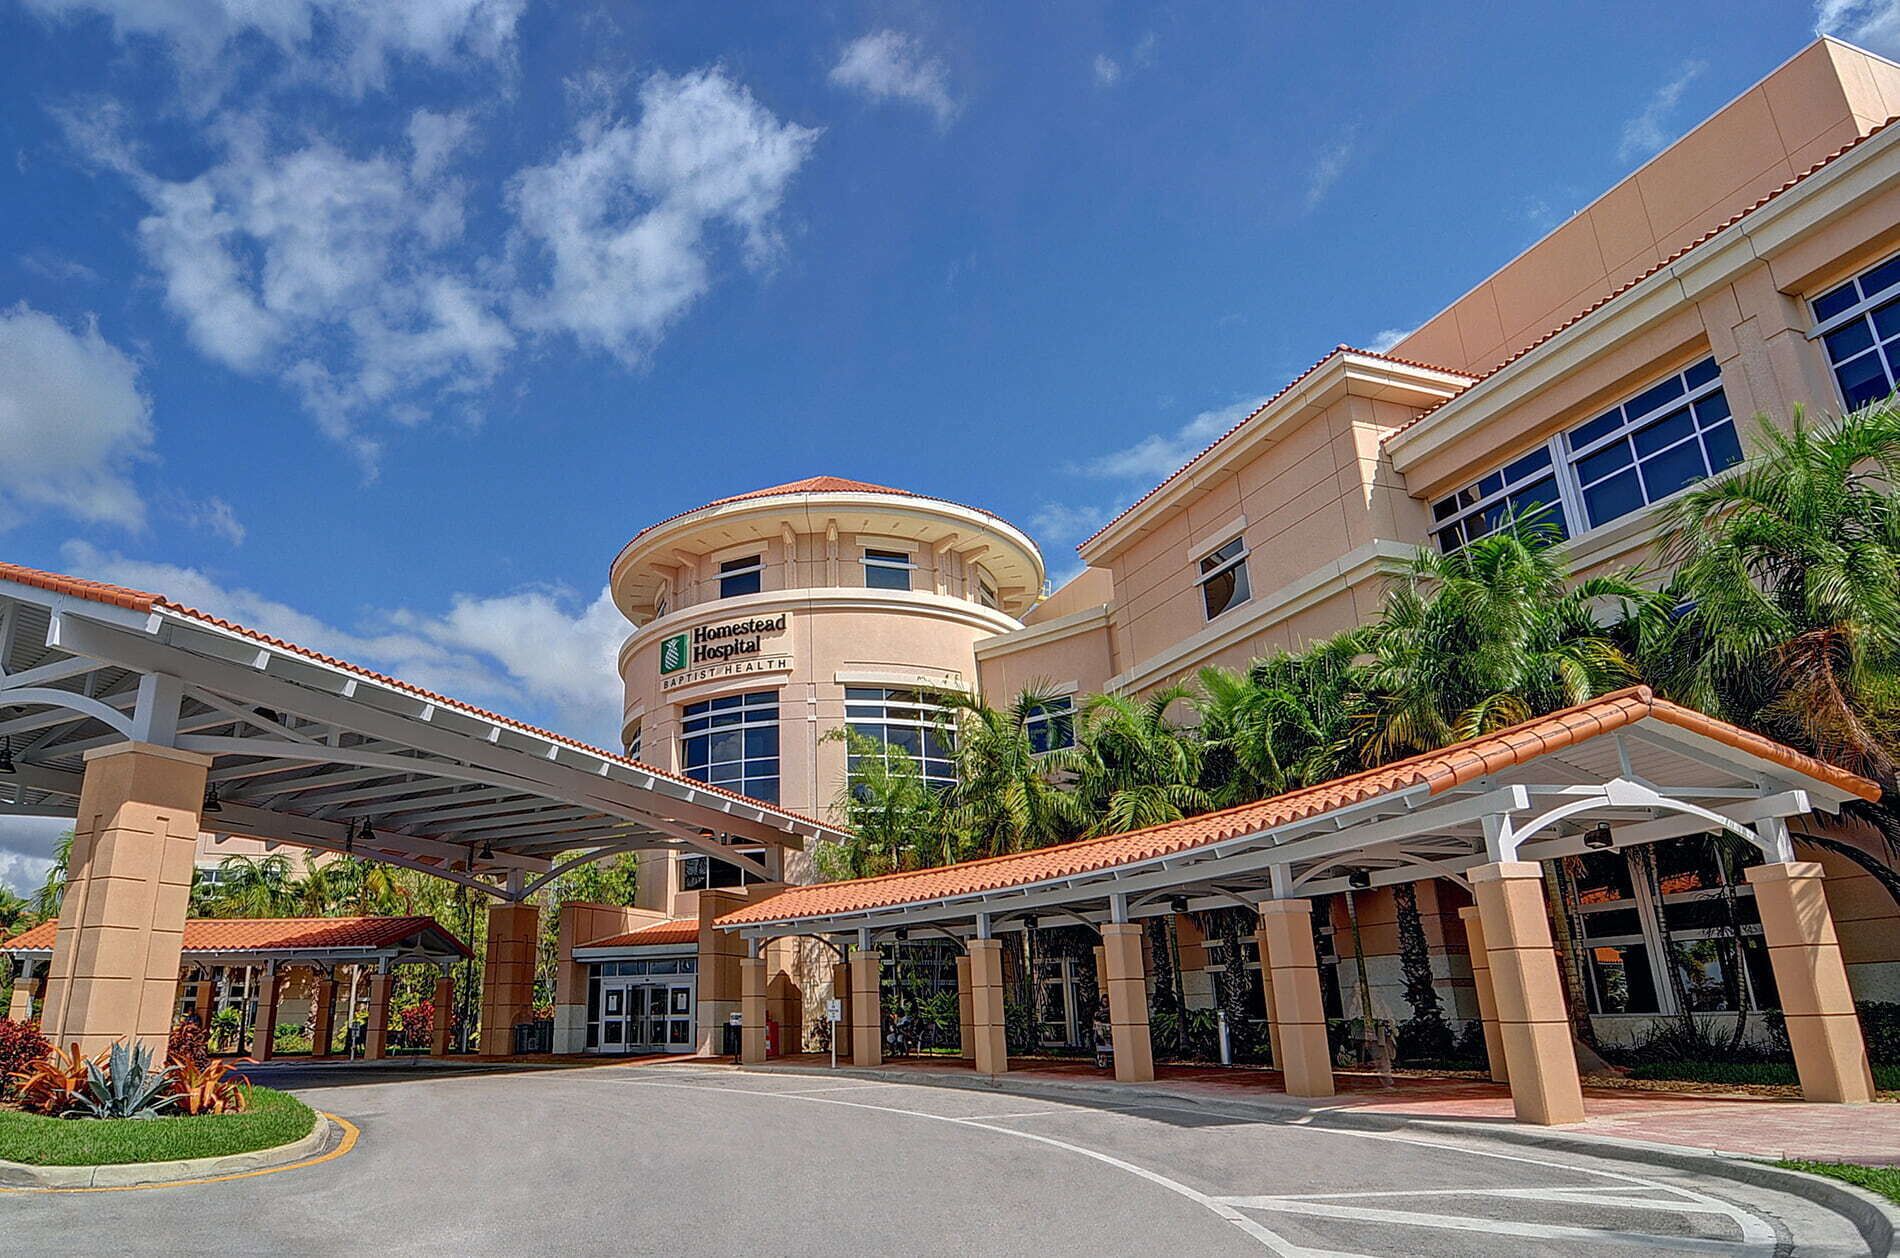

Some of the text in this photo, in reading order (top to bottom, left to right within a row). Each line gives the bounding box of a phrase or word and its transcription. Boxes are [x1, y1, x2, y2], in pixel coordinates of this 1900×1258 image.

[693, 613, 787, 644] Homestead
[693, 636, 761, 662] Hospital
[663, 659, 786, 690] BAPTIST HEALTH
